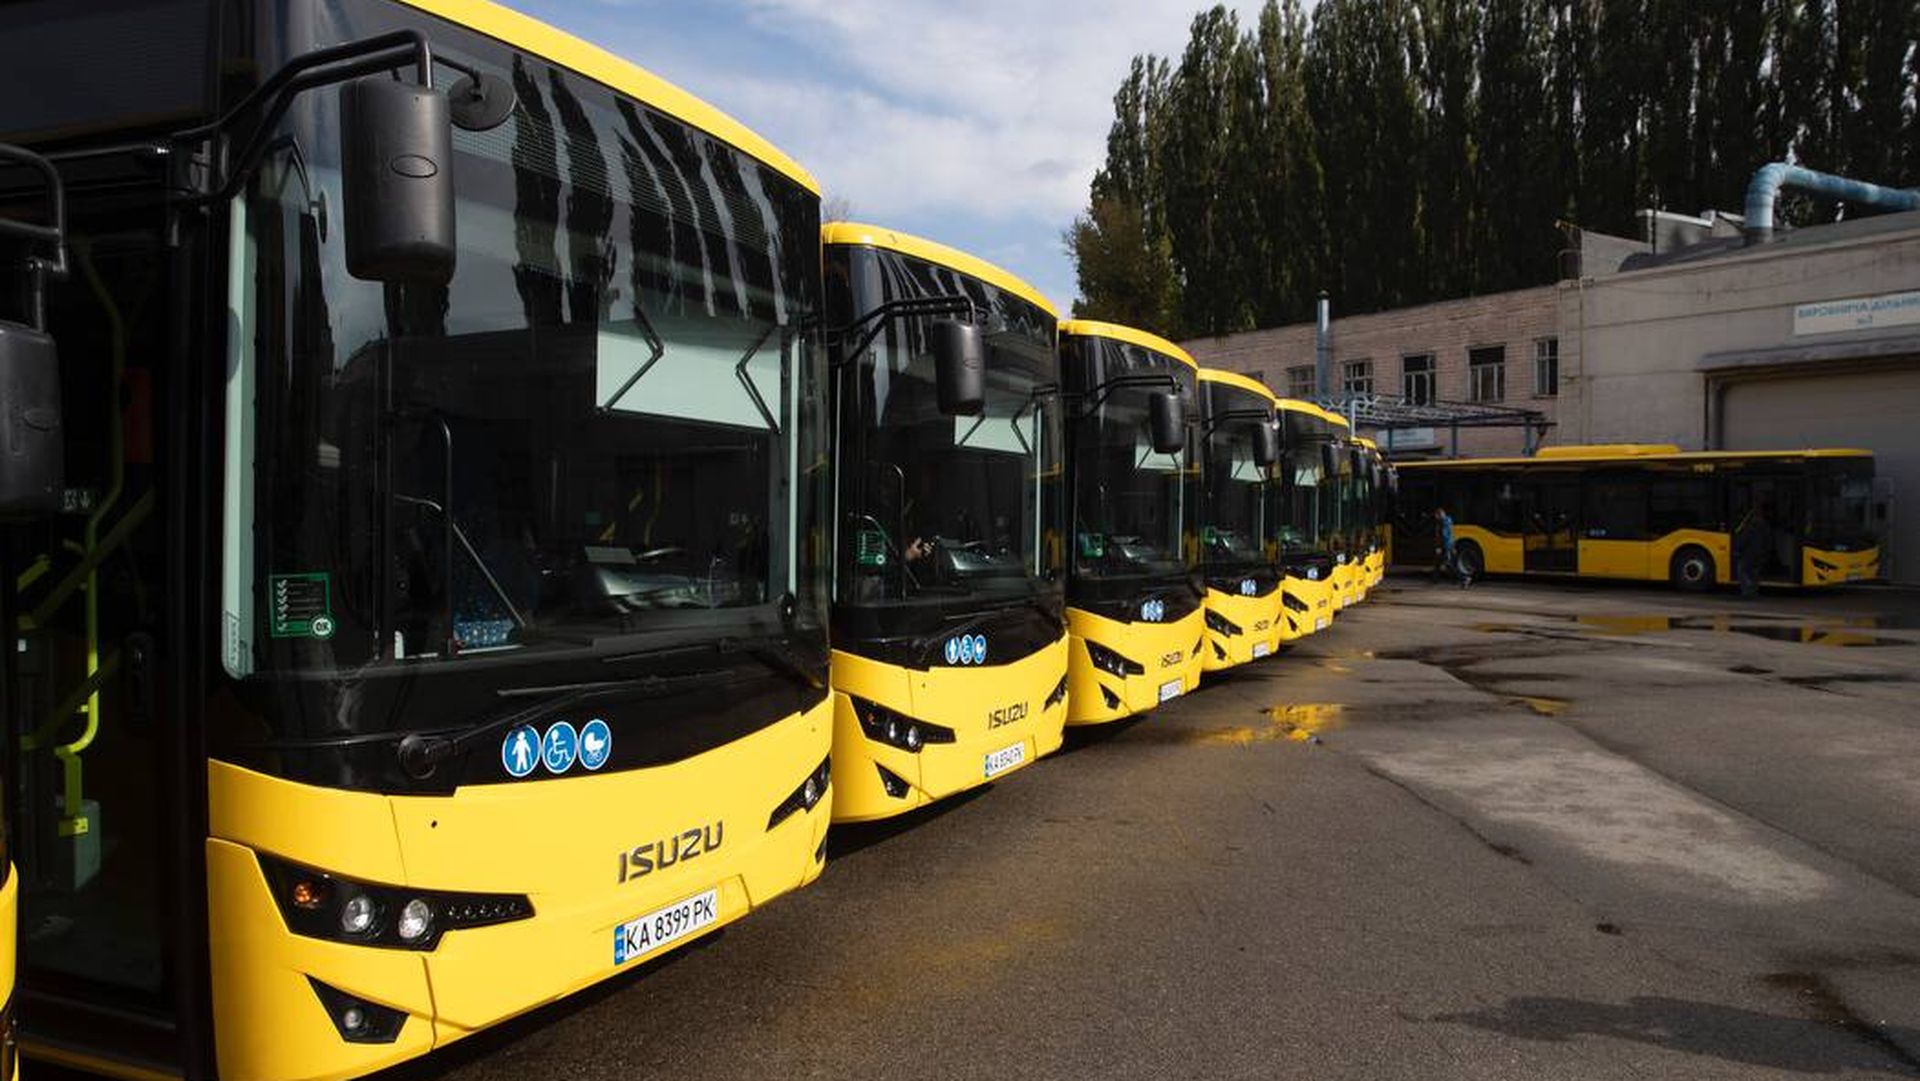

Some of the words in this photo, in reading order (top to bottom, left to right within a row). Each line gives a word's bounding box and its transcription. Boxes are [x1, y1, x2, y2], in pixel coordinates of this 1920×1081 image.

[988, 701, 1028, 730] ISUZU
[618, 820, 723, 884] ISUZU
[626, 922, 651, 954] KA
[655, 904, 690, 941] 8399
[694, 894, 714, 925] PK
